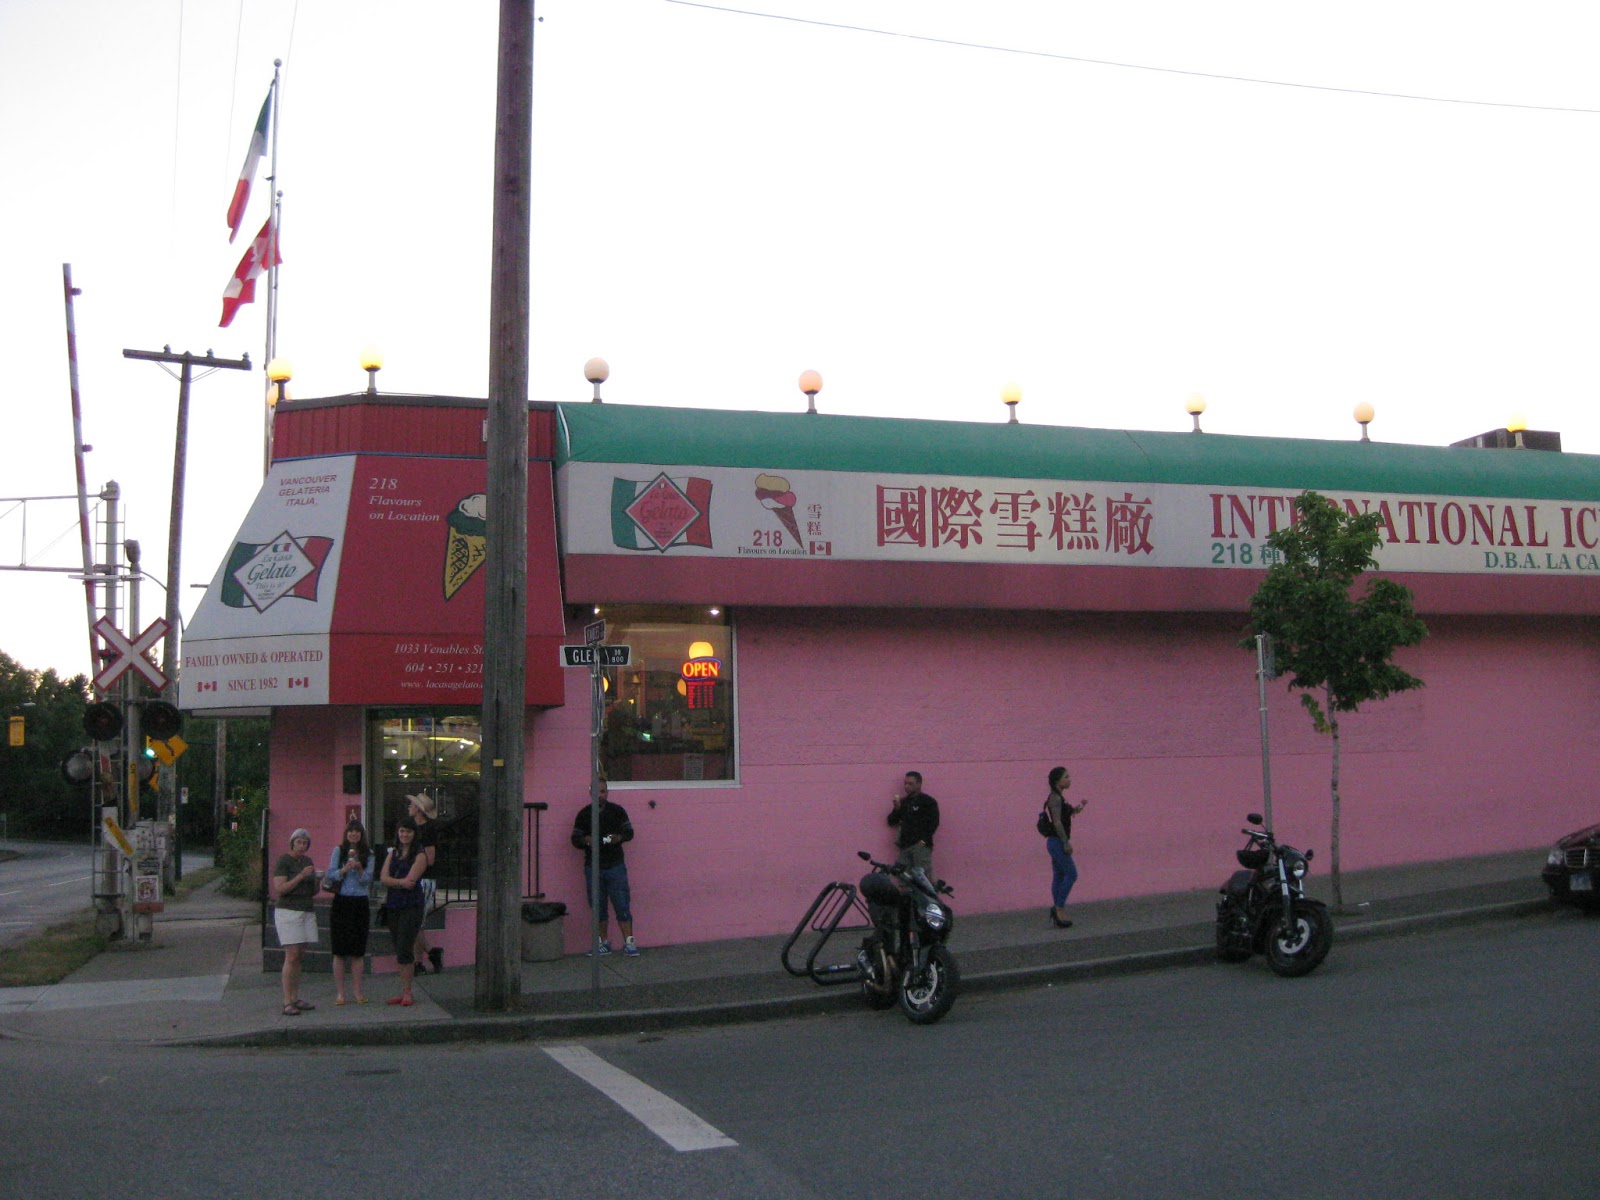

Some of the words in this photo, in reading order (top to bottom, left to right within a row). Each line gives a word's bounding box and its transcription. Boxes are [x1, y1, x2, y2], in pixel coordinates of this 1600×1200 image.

[280, 474, 337, 486] VANCOUVER
[369, 478, 398, 490] 218
[278, 485, 330, 497] GELATERIA
[286, 497, 316, 506] ITALIA
[369, 495, 422, 507] Flavours
[369, 512, 384, 520] on
[388, 510, 440, 522] Location
[876, 485, 1154, 555] 國際雪糕廠
[1209, 493, 1549, 548] INTATIONAL
[1561, 505, 1600, 550] IC
[752, 530, 783, 547] 218
[738, 546, 767, 556] Flavours
[778, 546, 807, 556] Location
[1211, 543, 1253, 565] 218
[1484, 551, 1541, 569] D.B.A.
[1546, 552, 1572, 570] LA
[247, 563, 297, 585] Gelato
[395, 643, 420, 654] 1033
[423, 643, 470, 655] Venables
[573, 649, 601, 663] GLE
[185, 654, 221, 668] FAMILY
[222, 652, 259, 666] OWNED
[260, 652, 268, 664] &
[270, 650, 323, 663] OPERATED
[405, 663, 425, 673] 604
[435, 663, 455, 674] 251
[465, 664, 484, 674] 321
[682, 662, 719, 677] OPEN
[227, 679, 257, 691] SINCE
[259, 677, 279, 690] 1982
